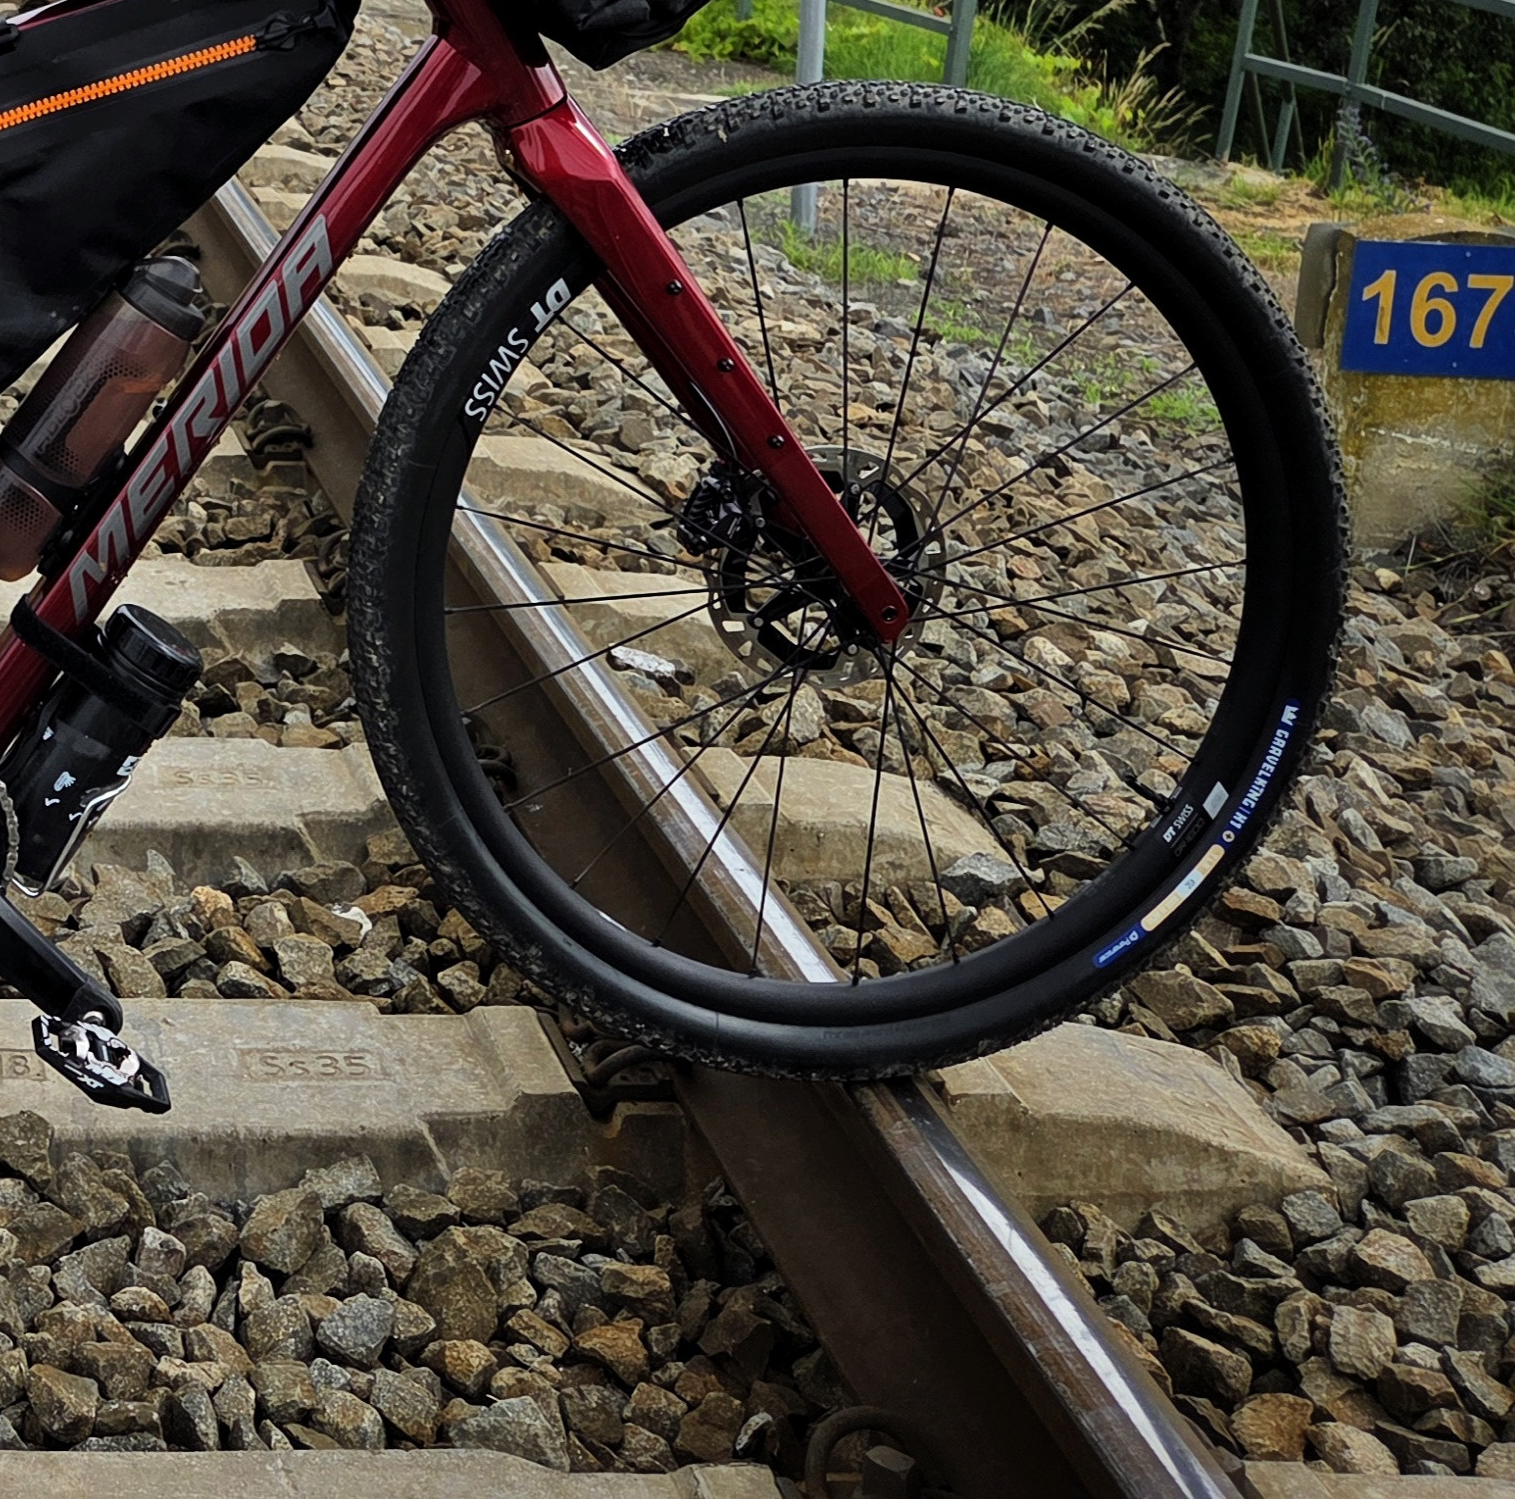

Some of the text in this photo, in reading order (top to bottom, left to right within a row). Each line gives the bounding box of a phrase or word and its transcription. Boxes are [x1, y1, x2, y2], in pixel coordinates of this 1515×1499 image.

[464, 278, 571, 421] DT SWISS
[1362, 270, 1514, 348] 167
[70, 214, 333, 624] MERIDA
[1243, 728, 1289, 809] GRAVELKING
[1163, 804, 1194, 843] DT SWISS
